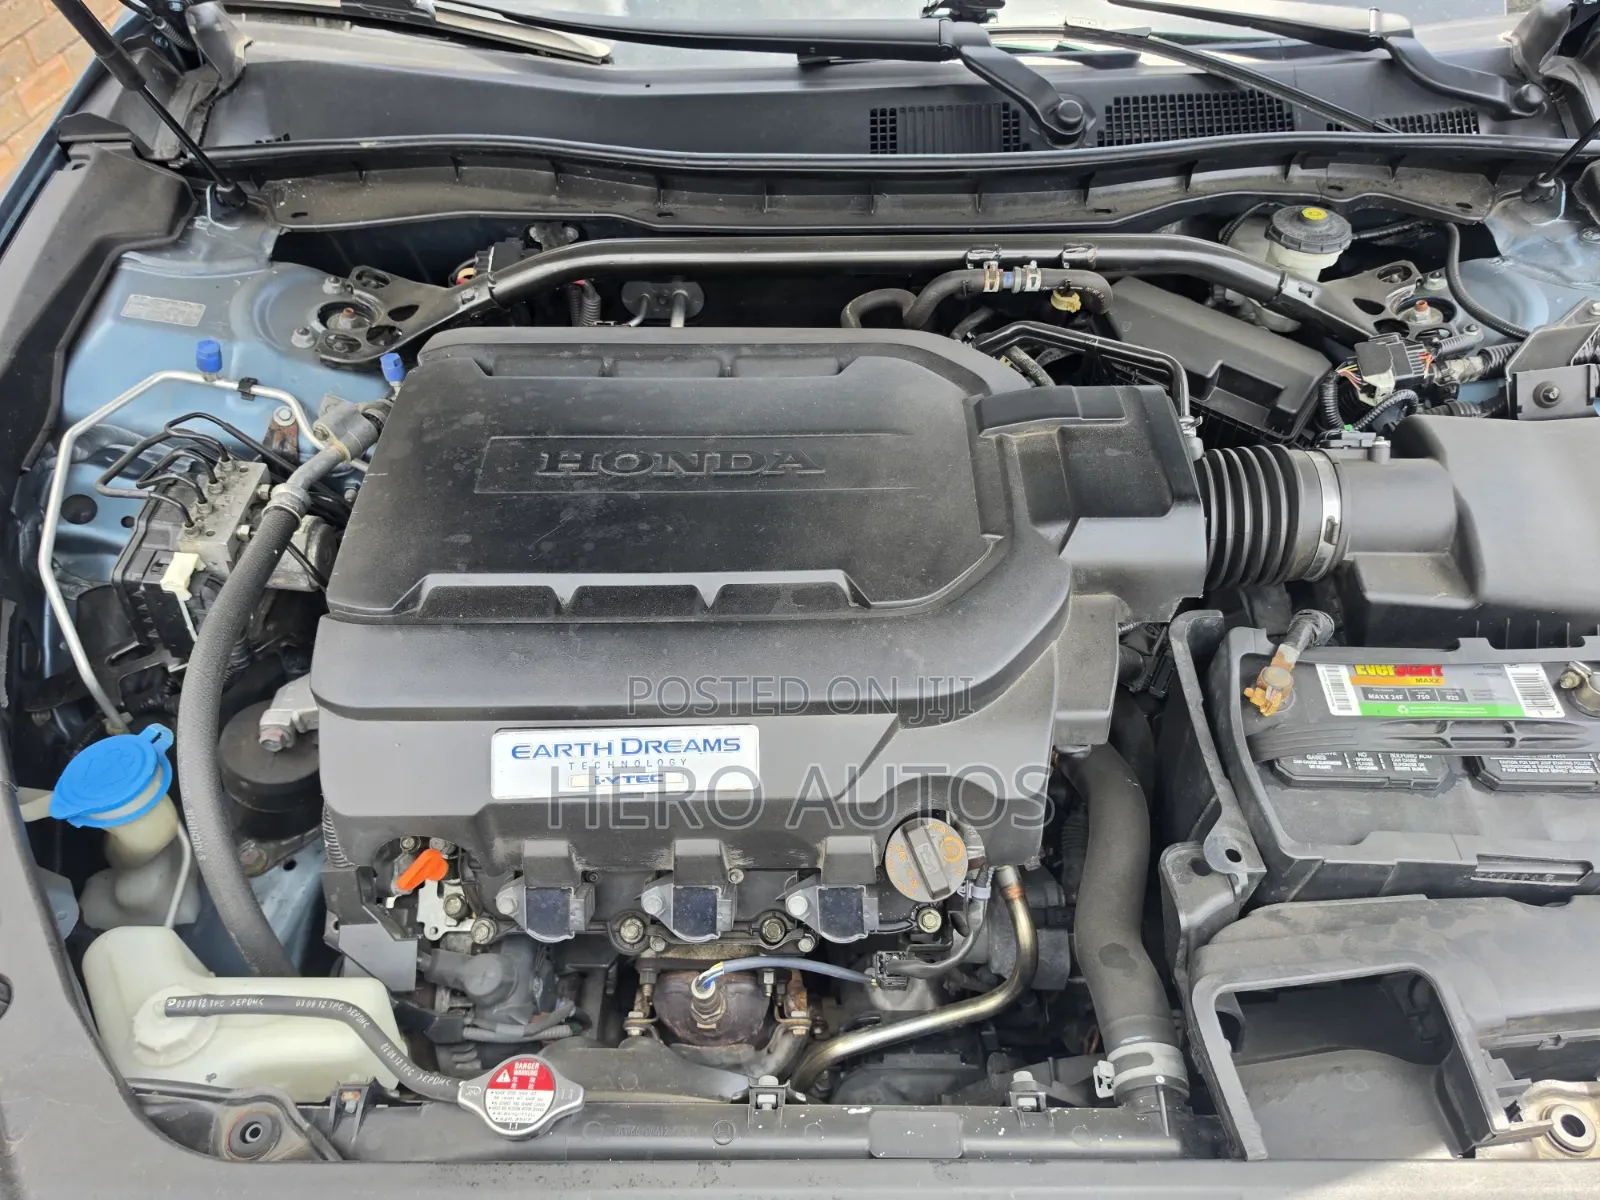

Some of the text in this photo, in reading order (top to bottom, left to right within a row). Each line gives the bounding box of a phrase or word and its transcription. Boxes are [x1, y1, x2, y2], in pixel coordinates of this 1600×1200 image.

[535, 450, 826, 476] HONDA
[511, 738, 741, 760] EARTH DREAMS
[568, 758, 687, 770] TECHNOLOGY
[594, 774, 664, 786] i-VTEC
